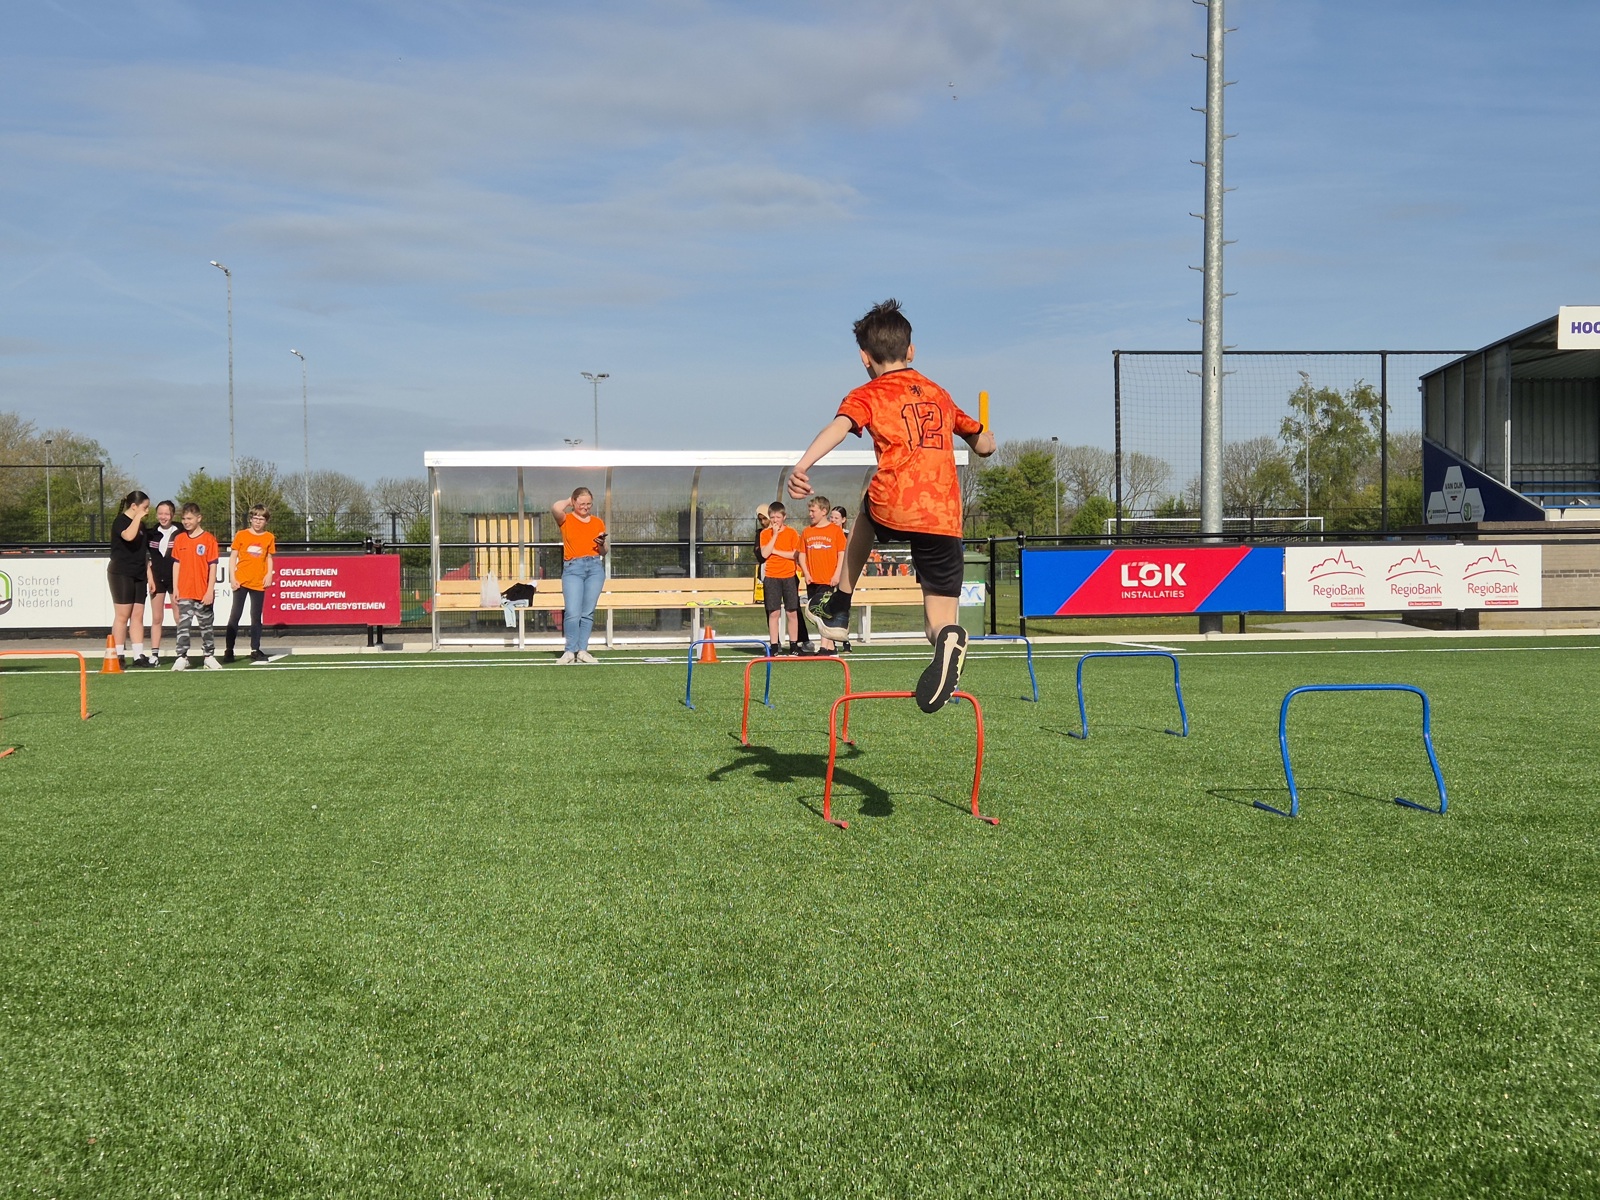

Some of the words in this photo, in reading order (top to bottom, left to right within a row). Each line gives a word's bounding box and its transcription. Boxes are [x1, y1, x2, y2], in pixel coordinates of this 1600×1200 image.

[901, 402, 943, 451] 12
[279, 568, 338, 576] GEVELSTENEN
[1121, 562, 1187, 587] LOK
[17, 575, 60, 586] Schroef
[279, 580, 332, 588] DAKPANNEN
[17, 587, 60, 598] Injectie
[280, 591, 346, 599] STEENSTRIPPEN
[1121, 590, 1185, 599] INSTALLATIES
[1313, 584, 1365, 599] RegioBank
[1390, 583, 1442, 598] RegioBank
[1467, 582, 1519, 597] RegioBank
[17, 597, 73, 608] Nederland
[280, 602, 386, 611] GEVEL-ISOLATIESYSTEMEN
